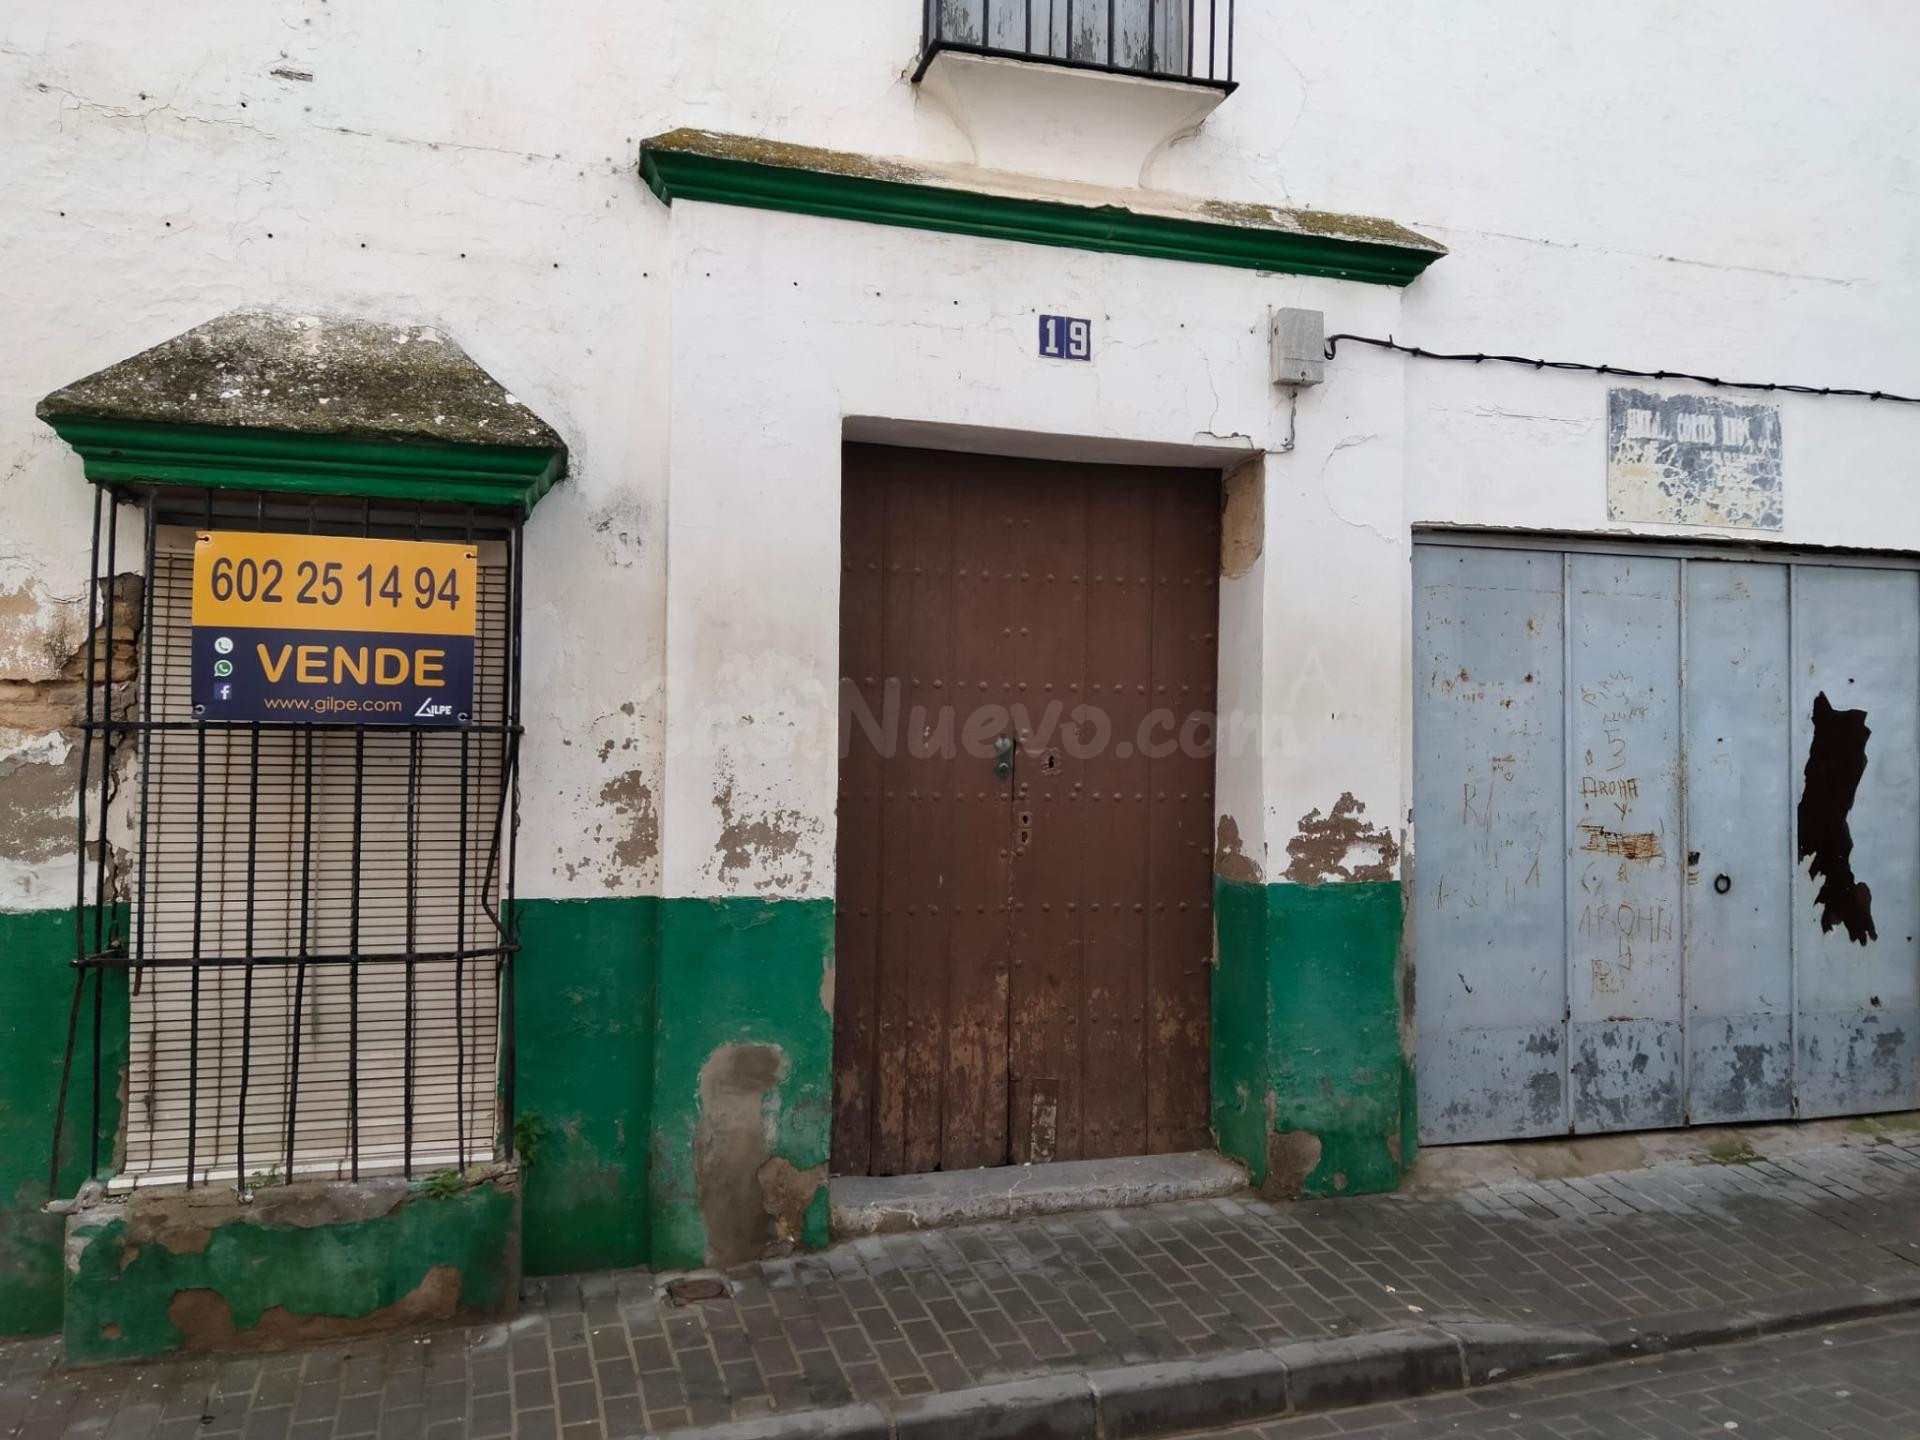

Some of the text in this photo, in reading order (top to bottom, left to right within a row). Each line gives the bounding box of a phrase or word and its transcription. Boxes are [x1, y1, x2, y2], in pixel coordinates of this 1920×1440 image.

[1045, 318, 1087, 356] 19
[211, 557, 460, 611] 602 25 14 94
[256, 643, 447, 687] VENDE
[263, 696, 402, 714] www.gilpe.com
